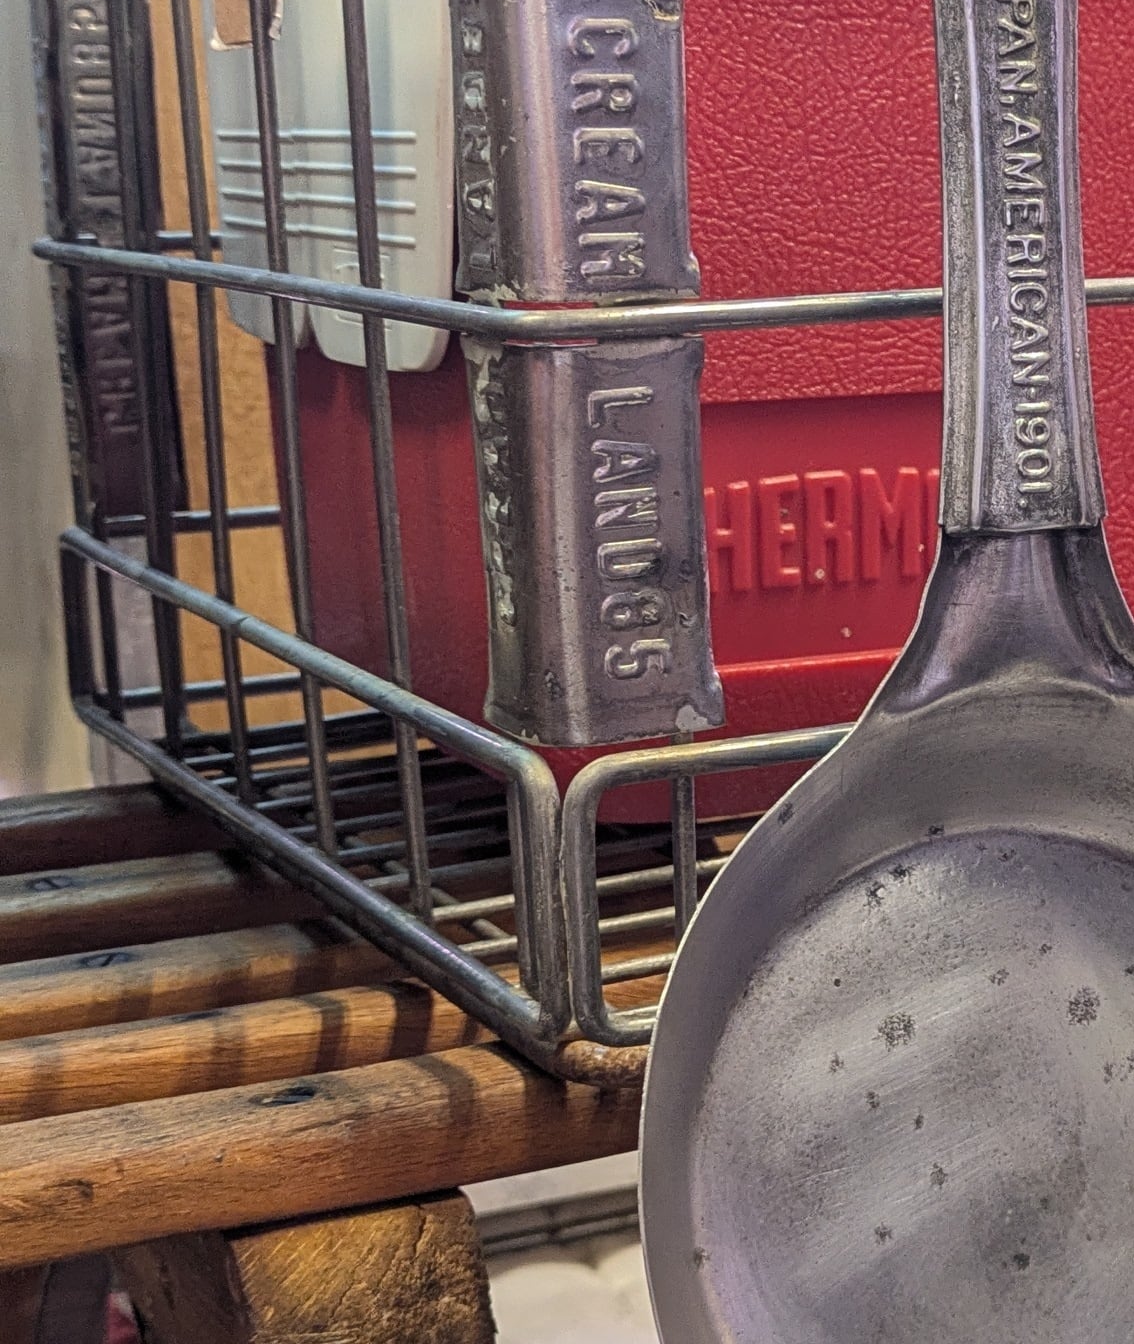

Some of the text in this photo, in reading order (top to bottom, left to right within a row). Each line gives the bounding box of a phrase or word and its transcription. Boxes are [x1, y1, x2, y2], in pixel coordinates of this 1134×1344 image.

[568, 17, 674, 681] CREAM LAND85
[703, 467, 940, 593] HERM
